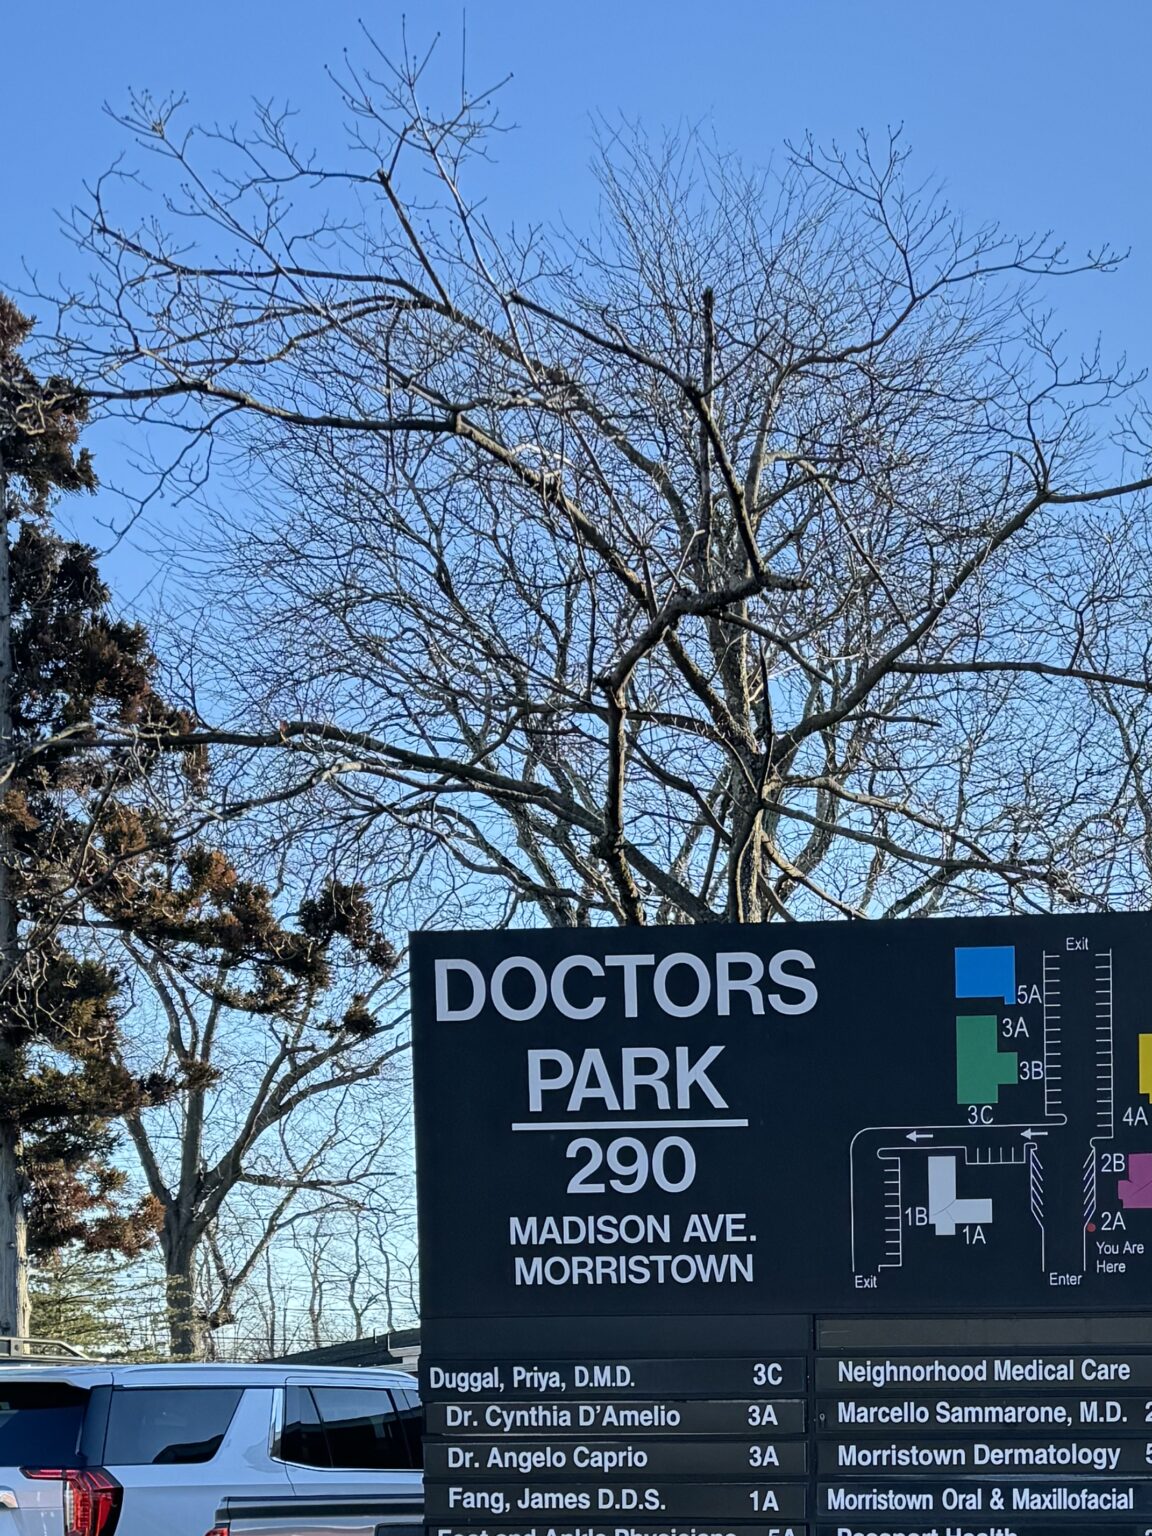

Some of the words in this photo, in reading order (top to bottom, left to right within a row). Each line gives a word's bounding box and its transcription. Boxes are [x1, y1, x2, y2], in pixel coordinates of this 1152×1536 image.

[1065, 936, 1089, 951] Exit
[434, 949, 819, 1022] DOCTORS
[1017, 985, 1042, 1004] 5A
[1002, 1016, 1030, 1038] 3A
[527, 1045, 730, 1113] PARK
[1019, 1062, 1043, 1079] 3B
[967, 1106, 993, 1124] 3C
[1122, 1105, 1149, 1127] 4A
[565, 1135, 697, 1194] 290
[1100, 1152, 1126, 1173] 2B
[905, 1208, 928, 1226] 1B
[1100, 1211, 1127, 1231] 2A
[509, 1214, 671, 1246] MADISON
[682, 1213, 757, 1243] AVE.
[962, 1226, 986, 1244] 1A
[1096, 1241, 1120, 1254] You
[1123, 1241, 1144, 1254] Are
[514, 1253, 754, 1286] MORRISTOWN
[1096, 1261, 1125, 1273] Here
[855, 1275, 877, 1288] Exit
[1049, 1273, 1082, 1285] Enter
[429, 1366, 505, 1393] Duggal,
[512, 1365, 566, 1393] Priya,
[574, 1365, 636, 1388] D.M.D.
[752, 1362, 783, 1386] 3C
[993, 1358, 1075, 1382] Medical
[1081, 1358, 1131, 1381] Care
[446, 1405, 478, 1427] Dr.
[485, 1402, 572, 1433] Cynthia
[747, 1404, 779, 1427] 3A
[837, 1401, 930, 1424] Marcello
[935, 1400, 1073, 1427] Sammarone,
[1079, 1400, 1128, 1423] M.D.
[447, 1446, 480, 1468] Dr.
[486, 1446, 567, 1474] Angelo
[573, 1445, 648, 1473] Caprio
[748, 1445, 780, 1467] 3A
[838, 1444, 966, 1467] Morristown
[973, 1442, 1121, 1470] Dermatology
[448, 1486, 511, 1515] Fang,
[516, 1487, 591, 1510] James
[597, 1488, 666, 1511] D.D.S.
[749, 1490, 780, 1512] 1A
[827, 1487, 934, 1511] Morristown
[941, 1487, 982, 1511] Oral
[989, 1487, 1005, 1511] &
[1012, 1487, 1134, 1511] Maxillofacial
